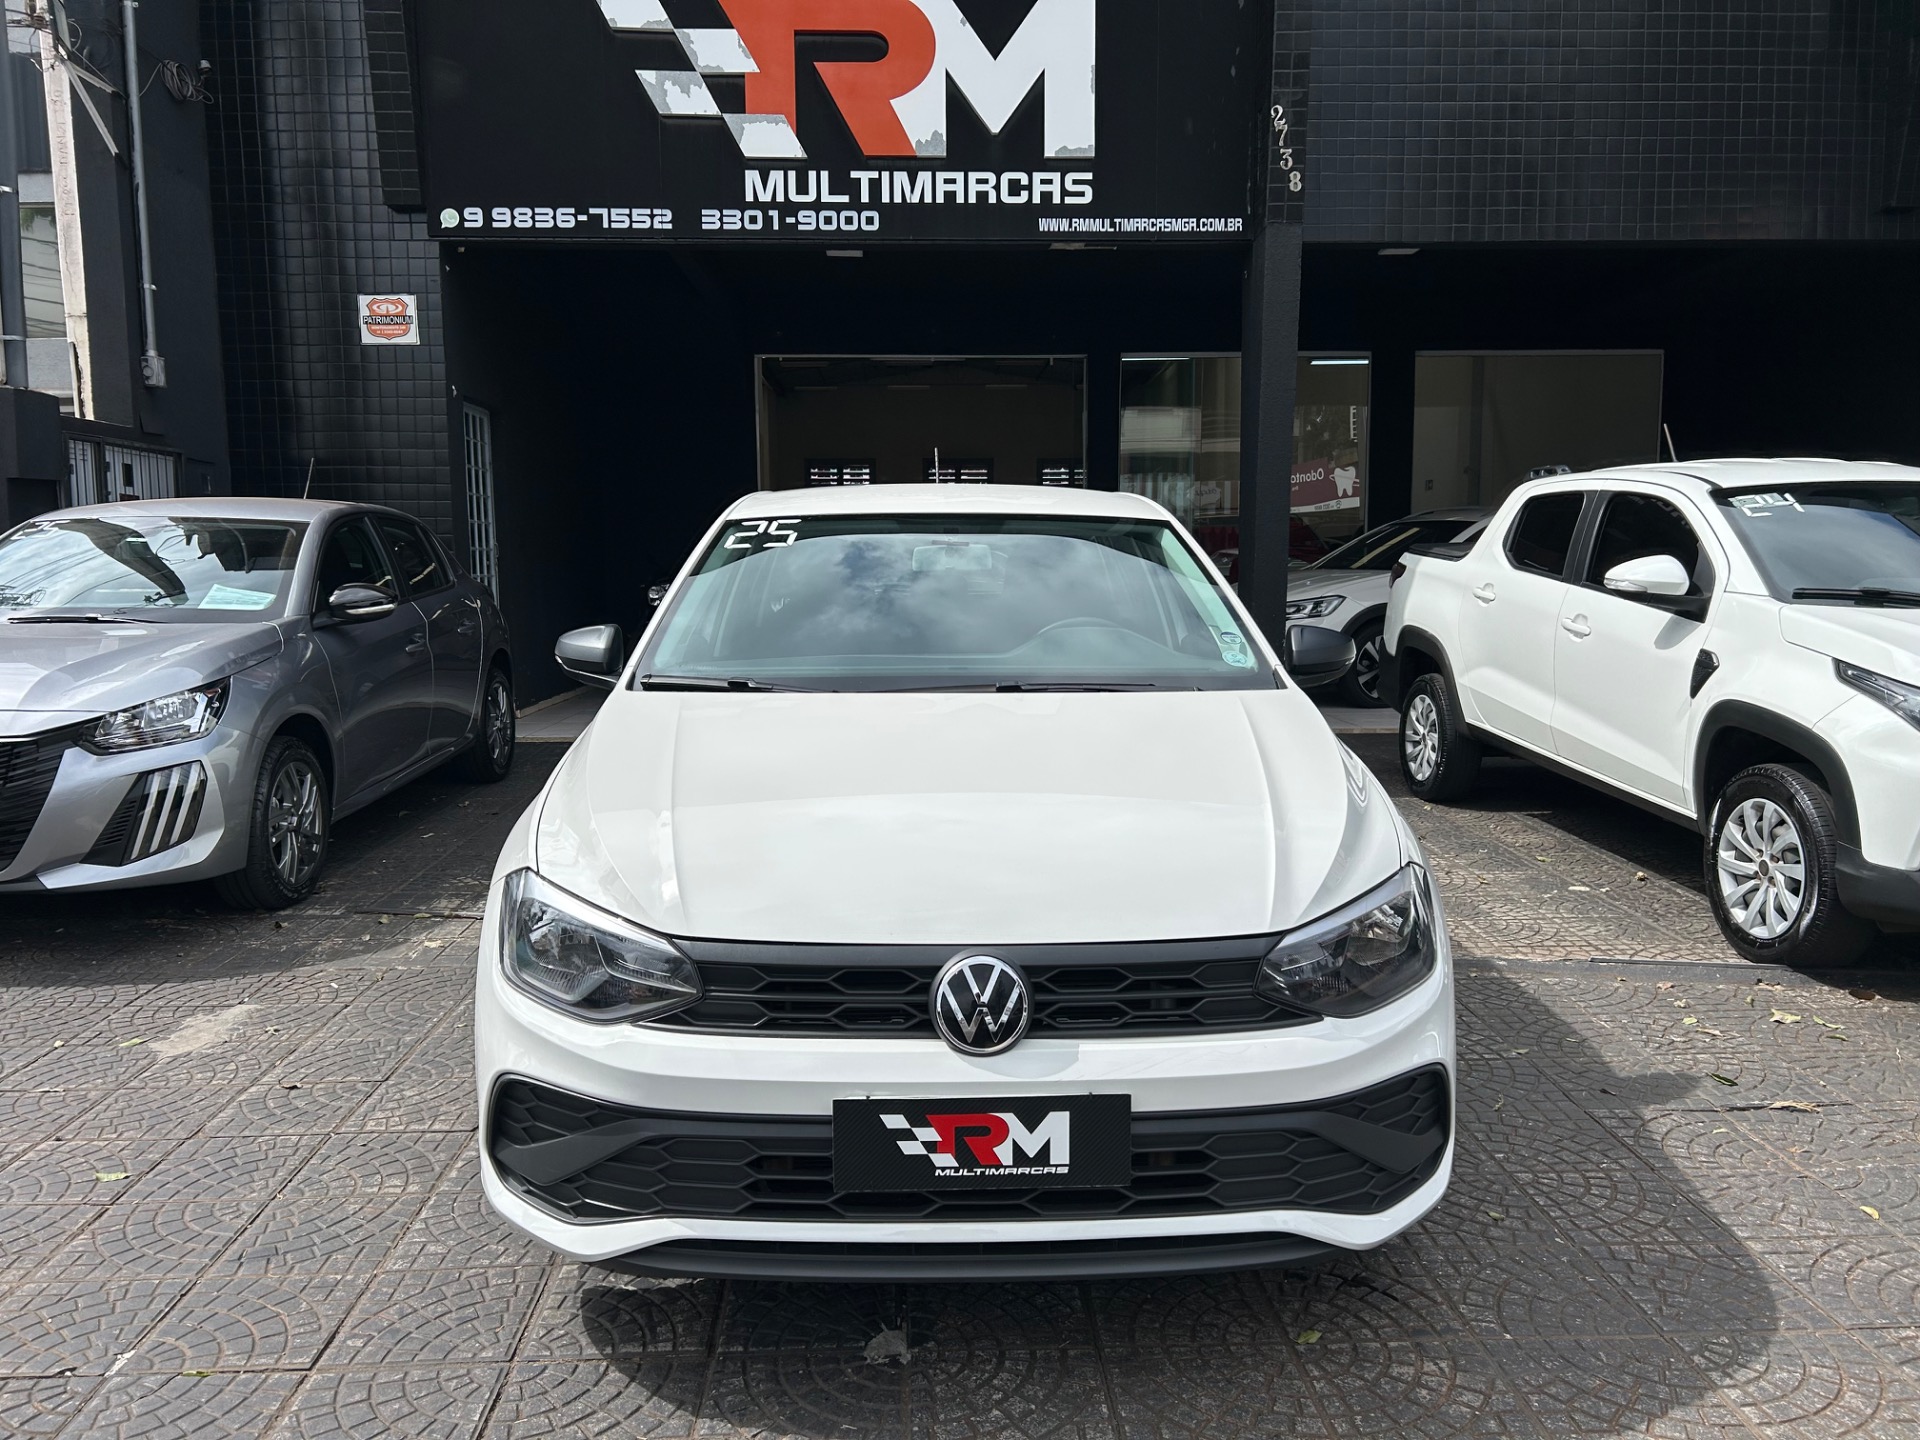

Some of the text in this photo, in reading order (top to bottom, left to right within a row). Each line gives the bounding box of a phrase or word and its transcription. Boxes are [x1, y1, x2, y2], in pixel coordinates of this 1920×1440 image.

[724, 0, 1096, 158] RM
[1270, 104, 1303, 192] 2738
[744, 169, 1094, 205] MULTIMARCAS
[463, 206, 674, 230] 9 9836-7552
[701, 208, 881, 232] 3301-9000
[1038, 217, 1243, 233] WWW.RMMULTIMARCASMGA.COM.BR
[363, 315, 413, 325] PATRIMONIUM
[9, 519, 72, 541] 25
[723, 518, 803, 550] 25
[926, 1110, 1070, 1167] RM
[934, 1165, 1070, 1177] MULTIMARCAS
